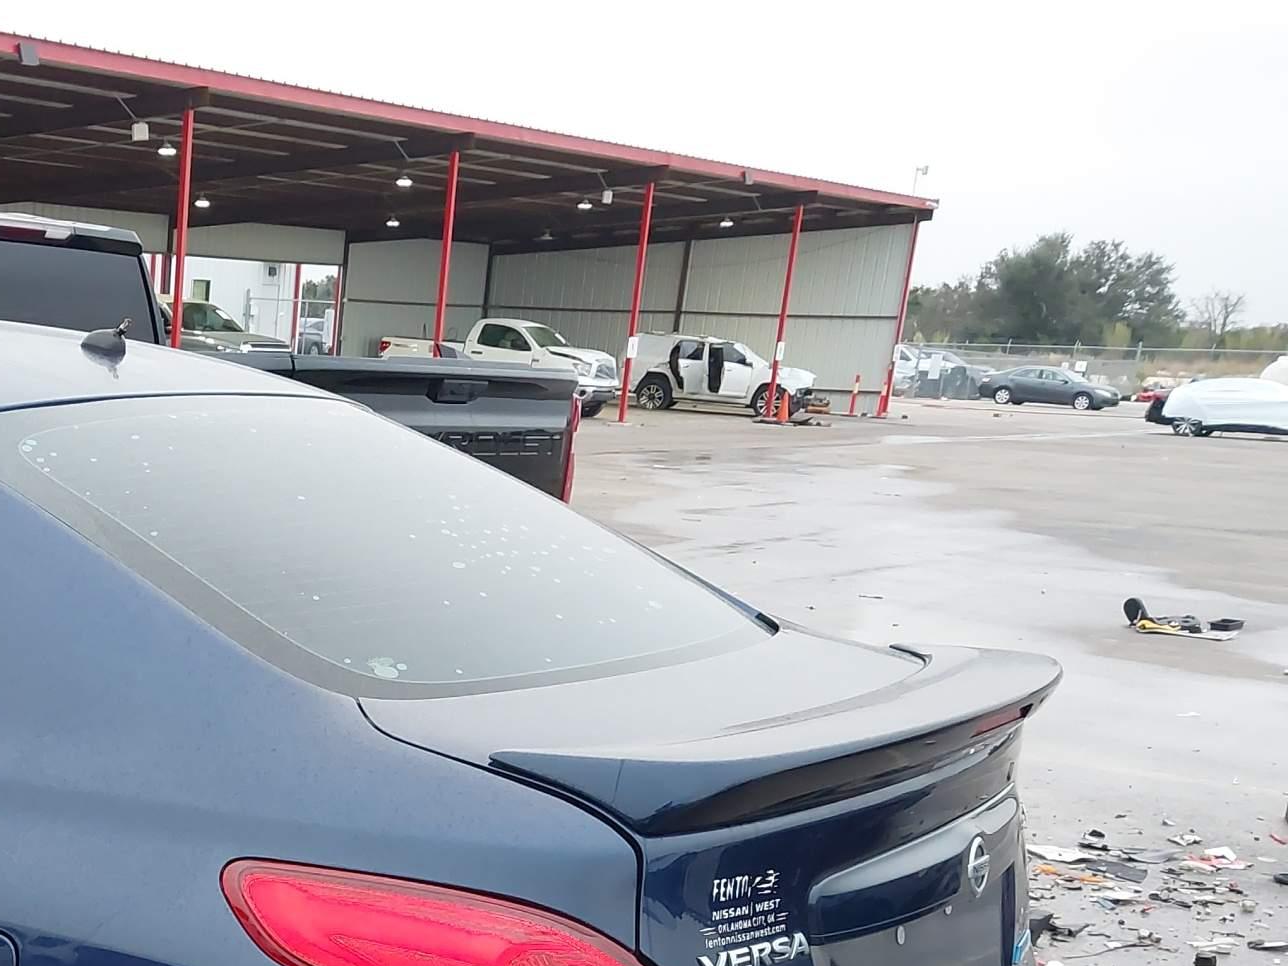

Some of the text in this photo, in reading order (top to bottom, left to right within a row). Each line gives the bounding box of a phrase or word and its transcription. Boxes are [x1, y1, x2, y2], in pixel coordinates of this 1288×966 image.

[712, 898, 781, 921] NISSAN WEST
[705, 924, 786, 949] fentonnissanwest.com
[717, 919, 752, 934] OKLAHOMA
